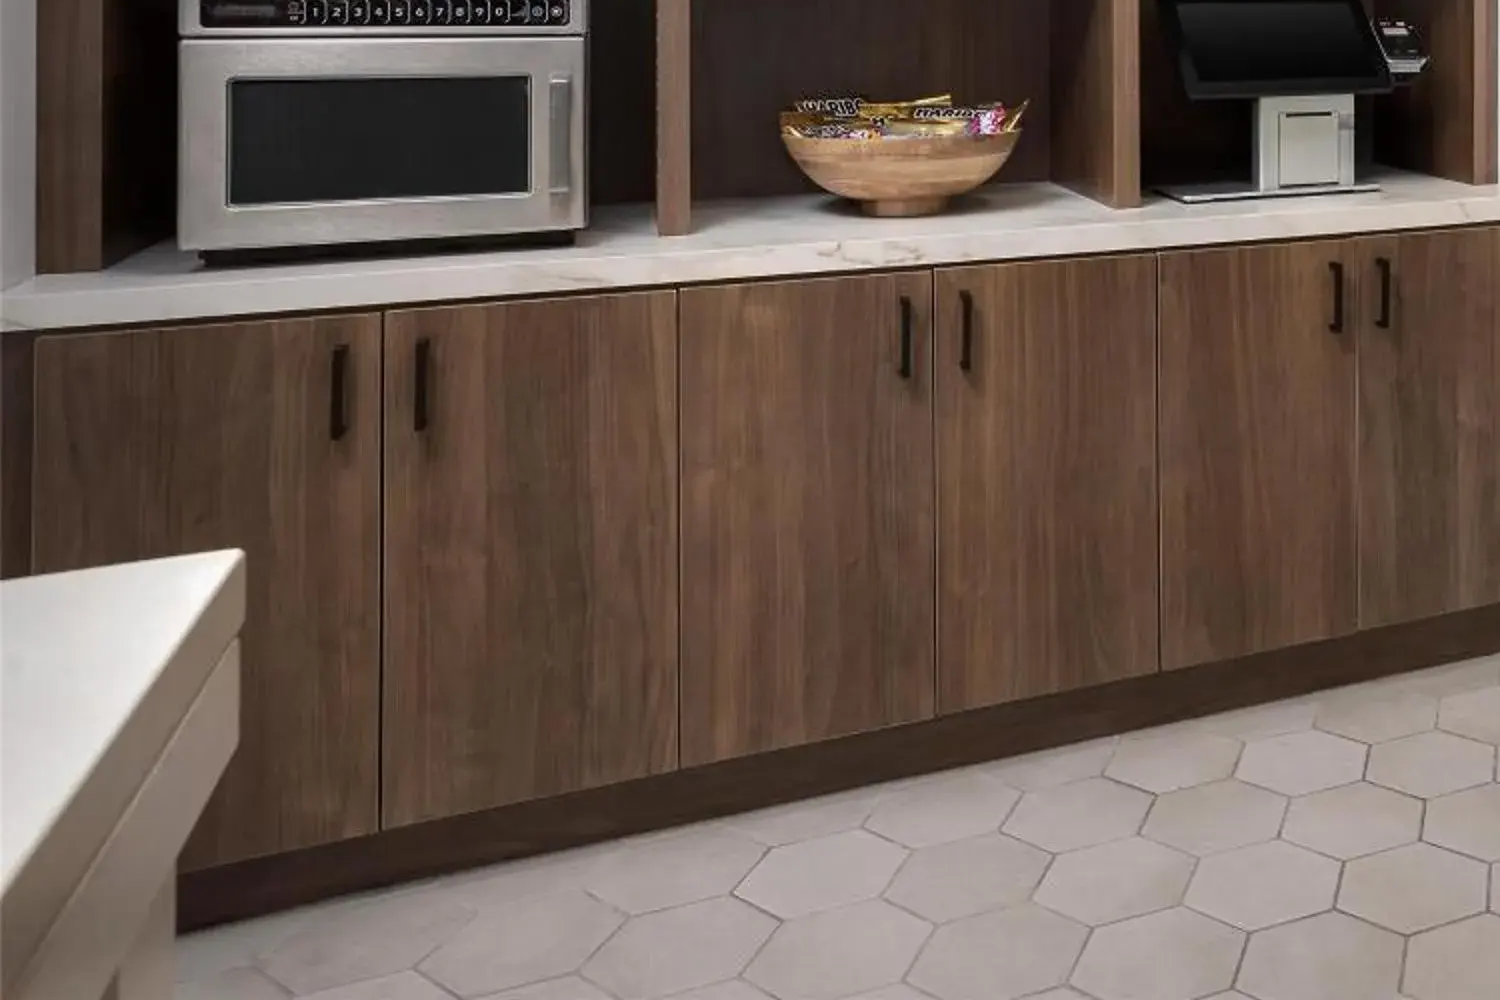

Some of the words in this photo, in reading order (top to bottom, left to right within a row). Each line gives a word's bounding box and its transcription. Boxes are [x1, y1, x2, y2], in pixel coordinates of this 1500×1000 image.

[313, 7, 318, 17] 1
[332, 7, 341, 17] 2
[354, 7, 362, 17] 3
[375, 7, 383, 17] 4
[395, 7, 403, 17] 5
[415, 7, 424, 17] 6
[436, 7, 444, 17] 7
[455, 7, 465, 17] 8
[475, 7, 484, 17] 9
[495, 7, 504, 17] 0
